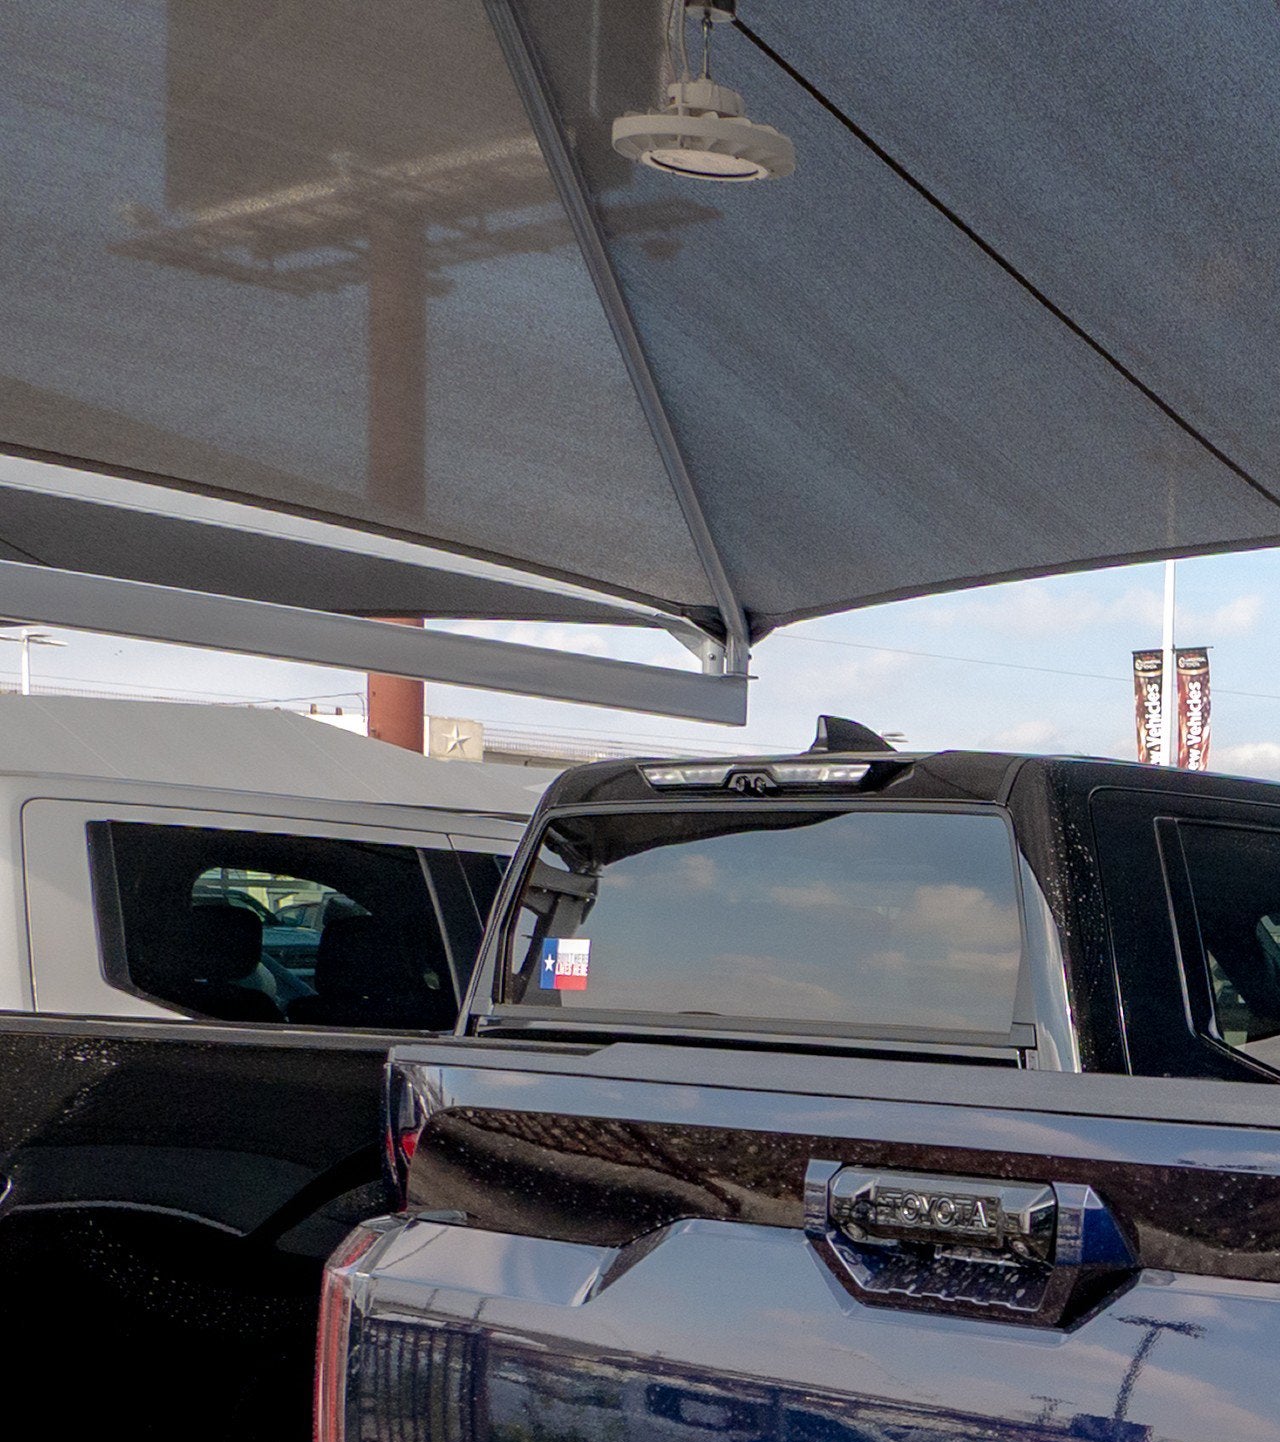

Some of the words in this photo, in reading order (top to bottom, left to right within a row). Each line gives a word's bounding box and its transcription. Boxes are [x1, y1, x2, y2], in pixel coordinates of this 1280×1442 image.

[1186, 681, 1202, 746] Vehicles
[1188, 749, 1201, 771] ew
[886, 1190, 988, 1230] TOYOTA
